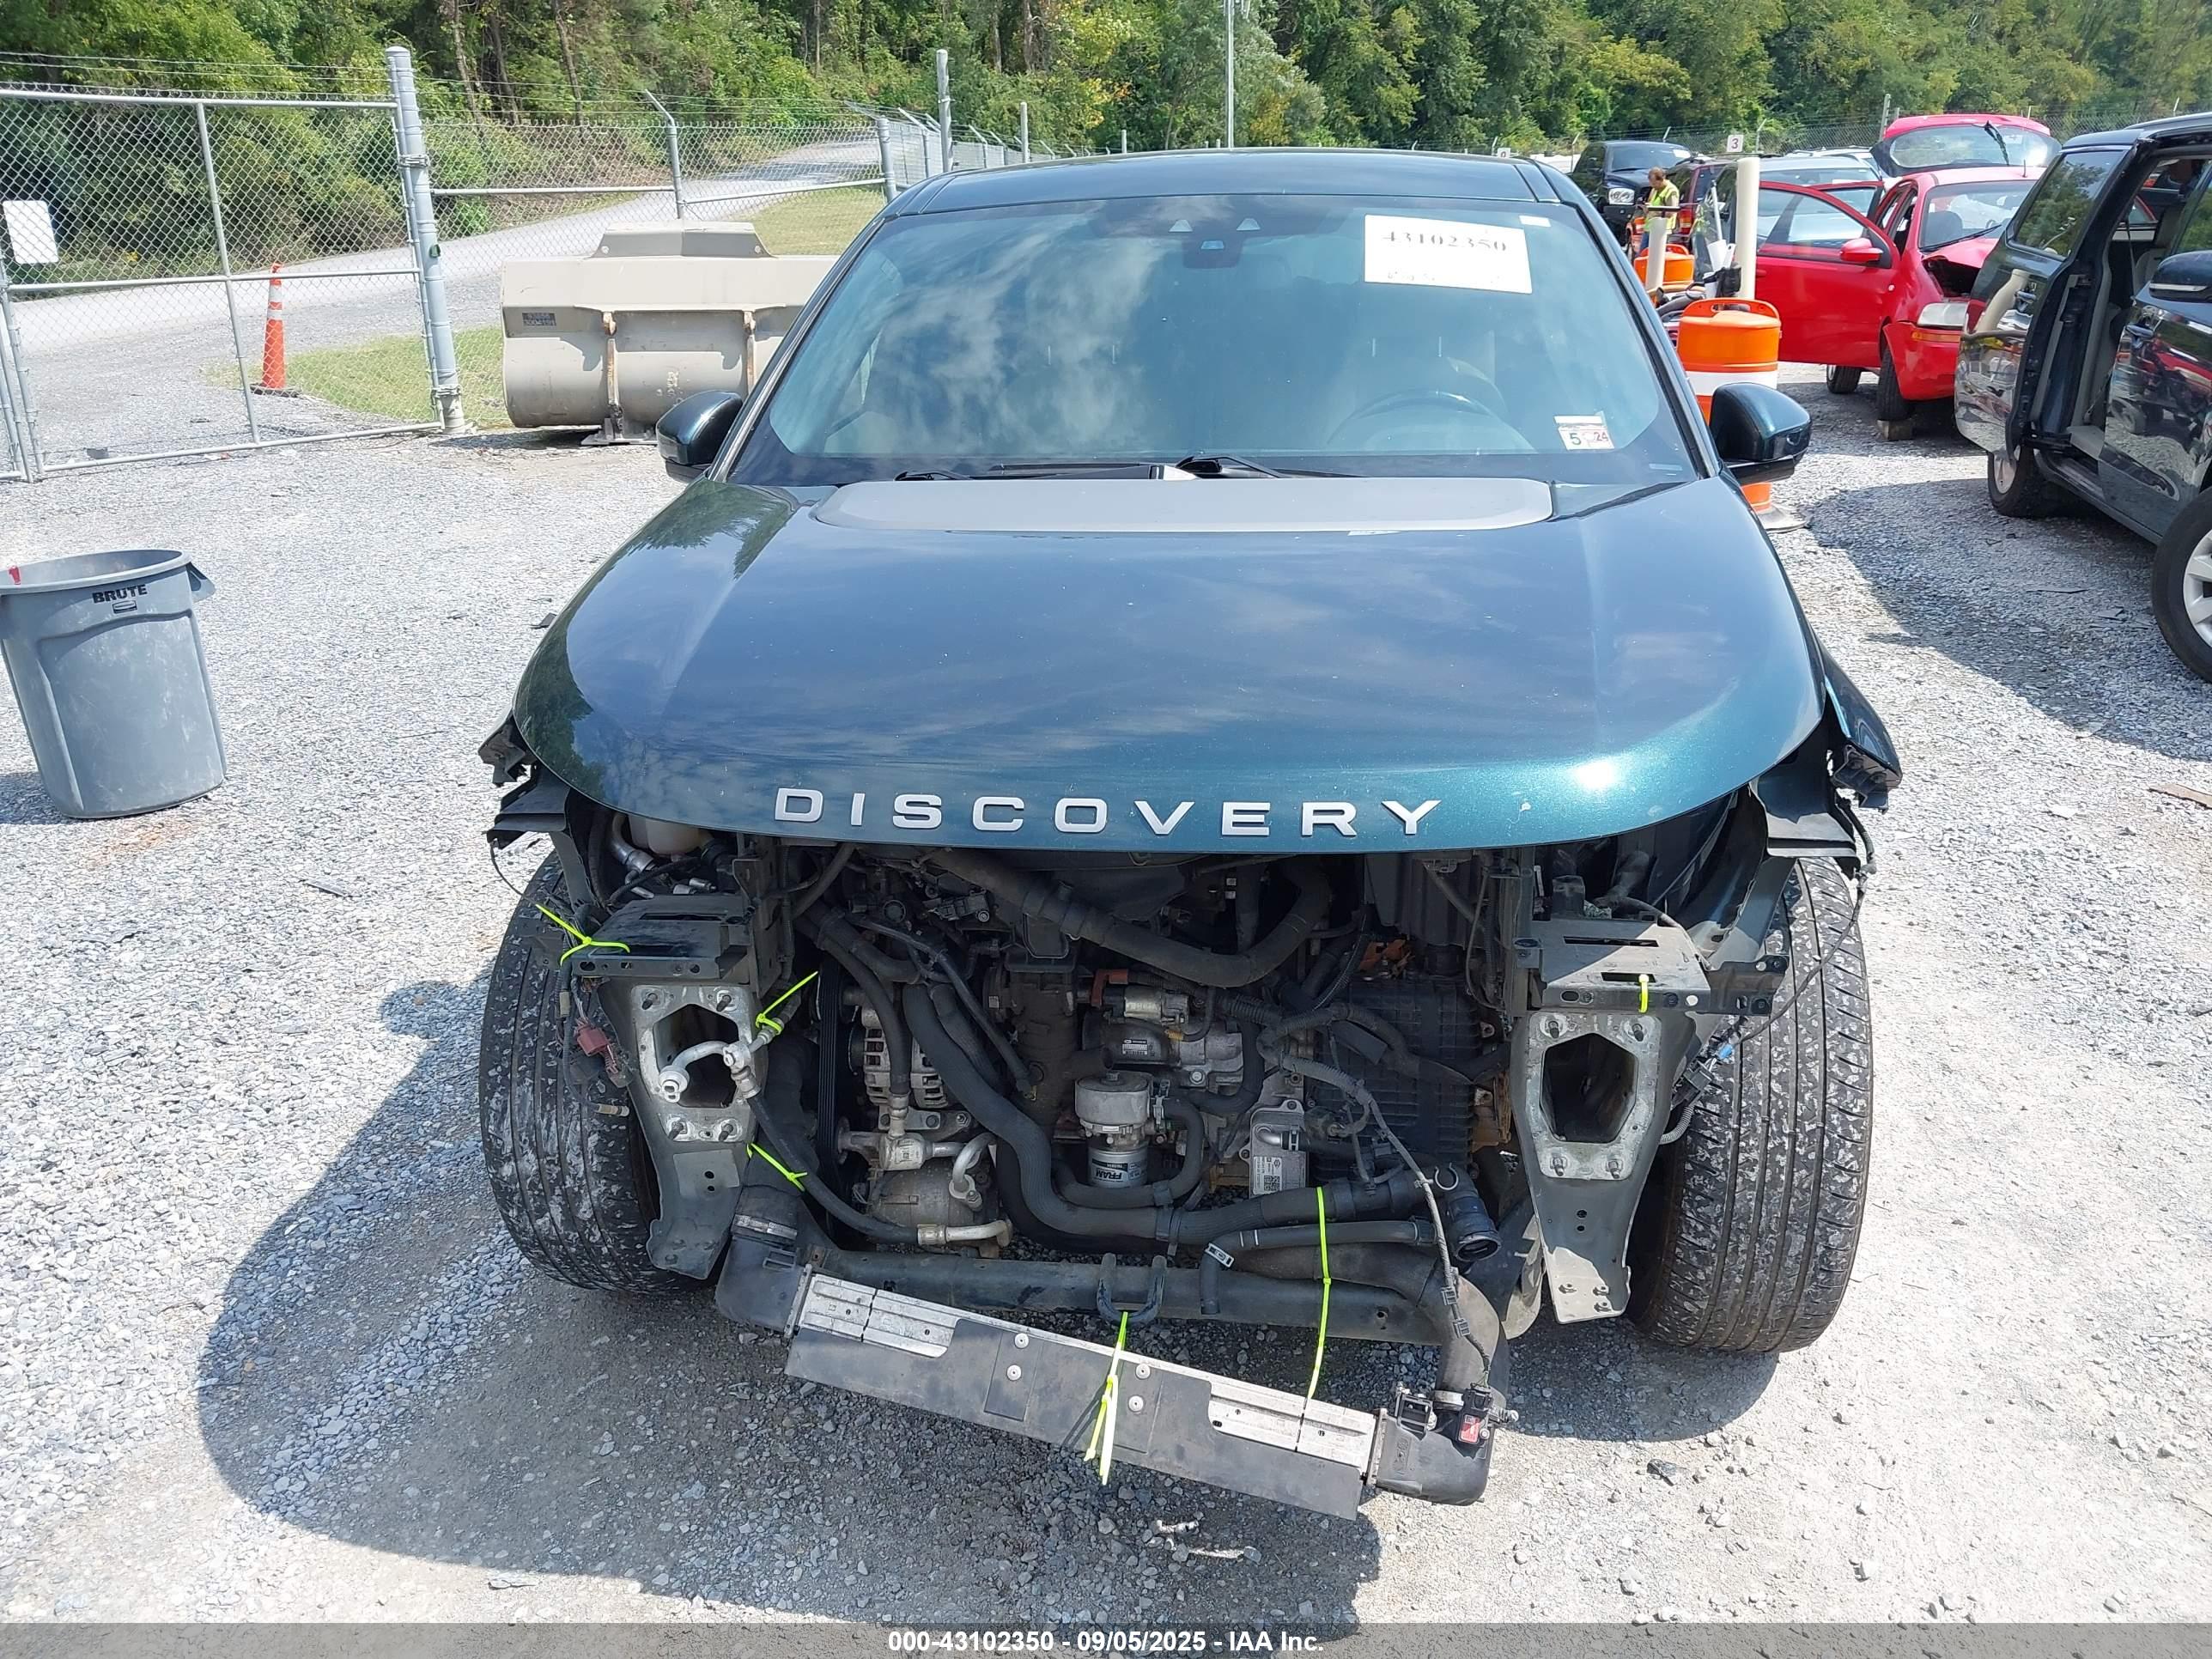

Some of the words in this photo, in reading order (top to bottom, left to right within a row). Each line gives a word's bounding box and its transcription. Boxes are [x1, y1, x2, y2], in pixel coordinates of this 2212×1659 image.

[1731, 138, 1739, 149] 3
[1569, 433, 1582, 445] 5
[93, 584, 148, 604] BRUTE
[775, 787, 1441, 836] DISCOVERY
